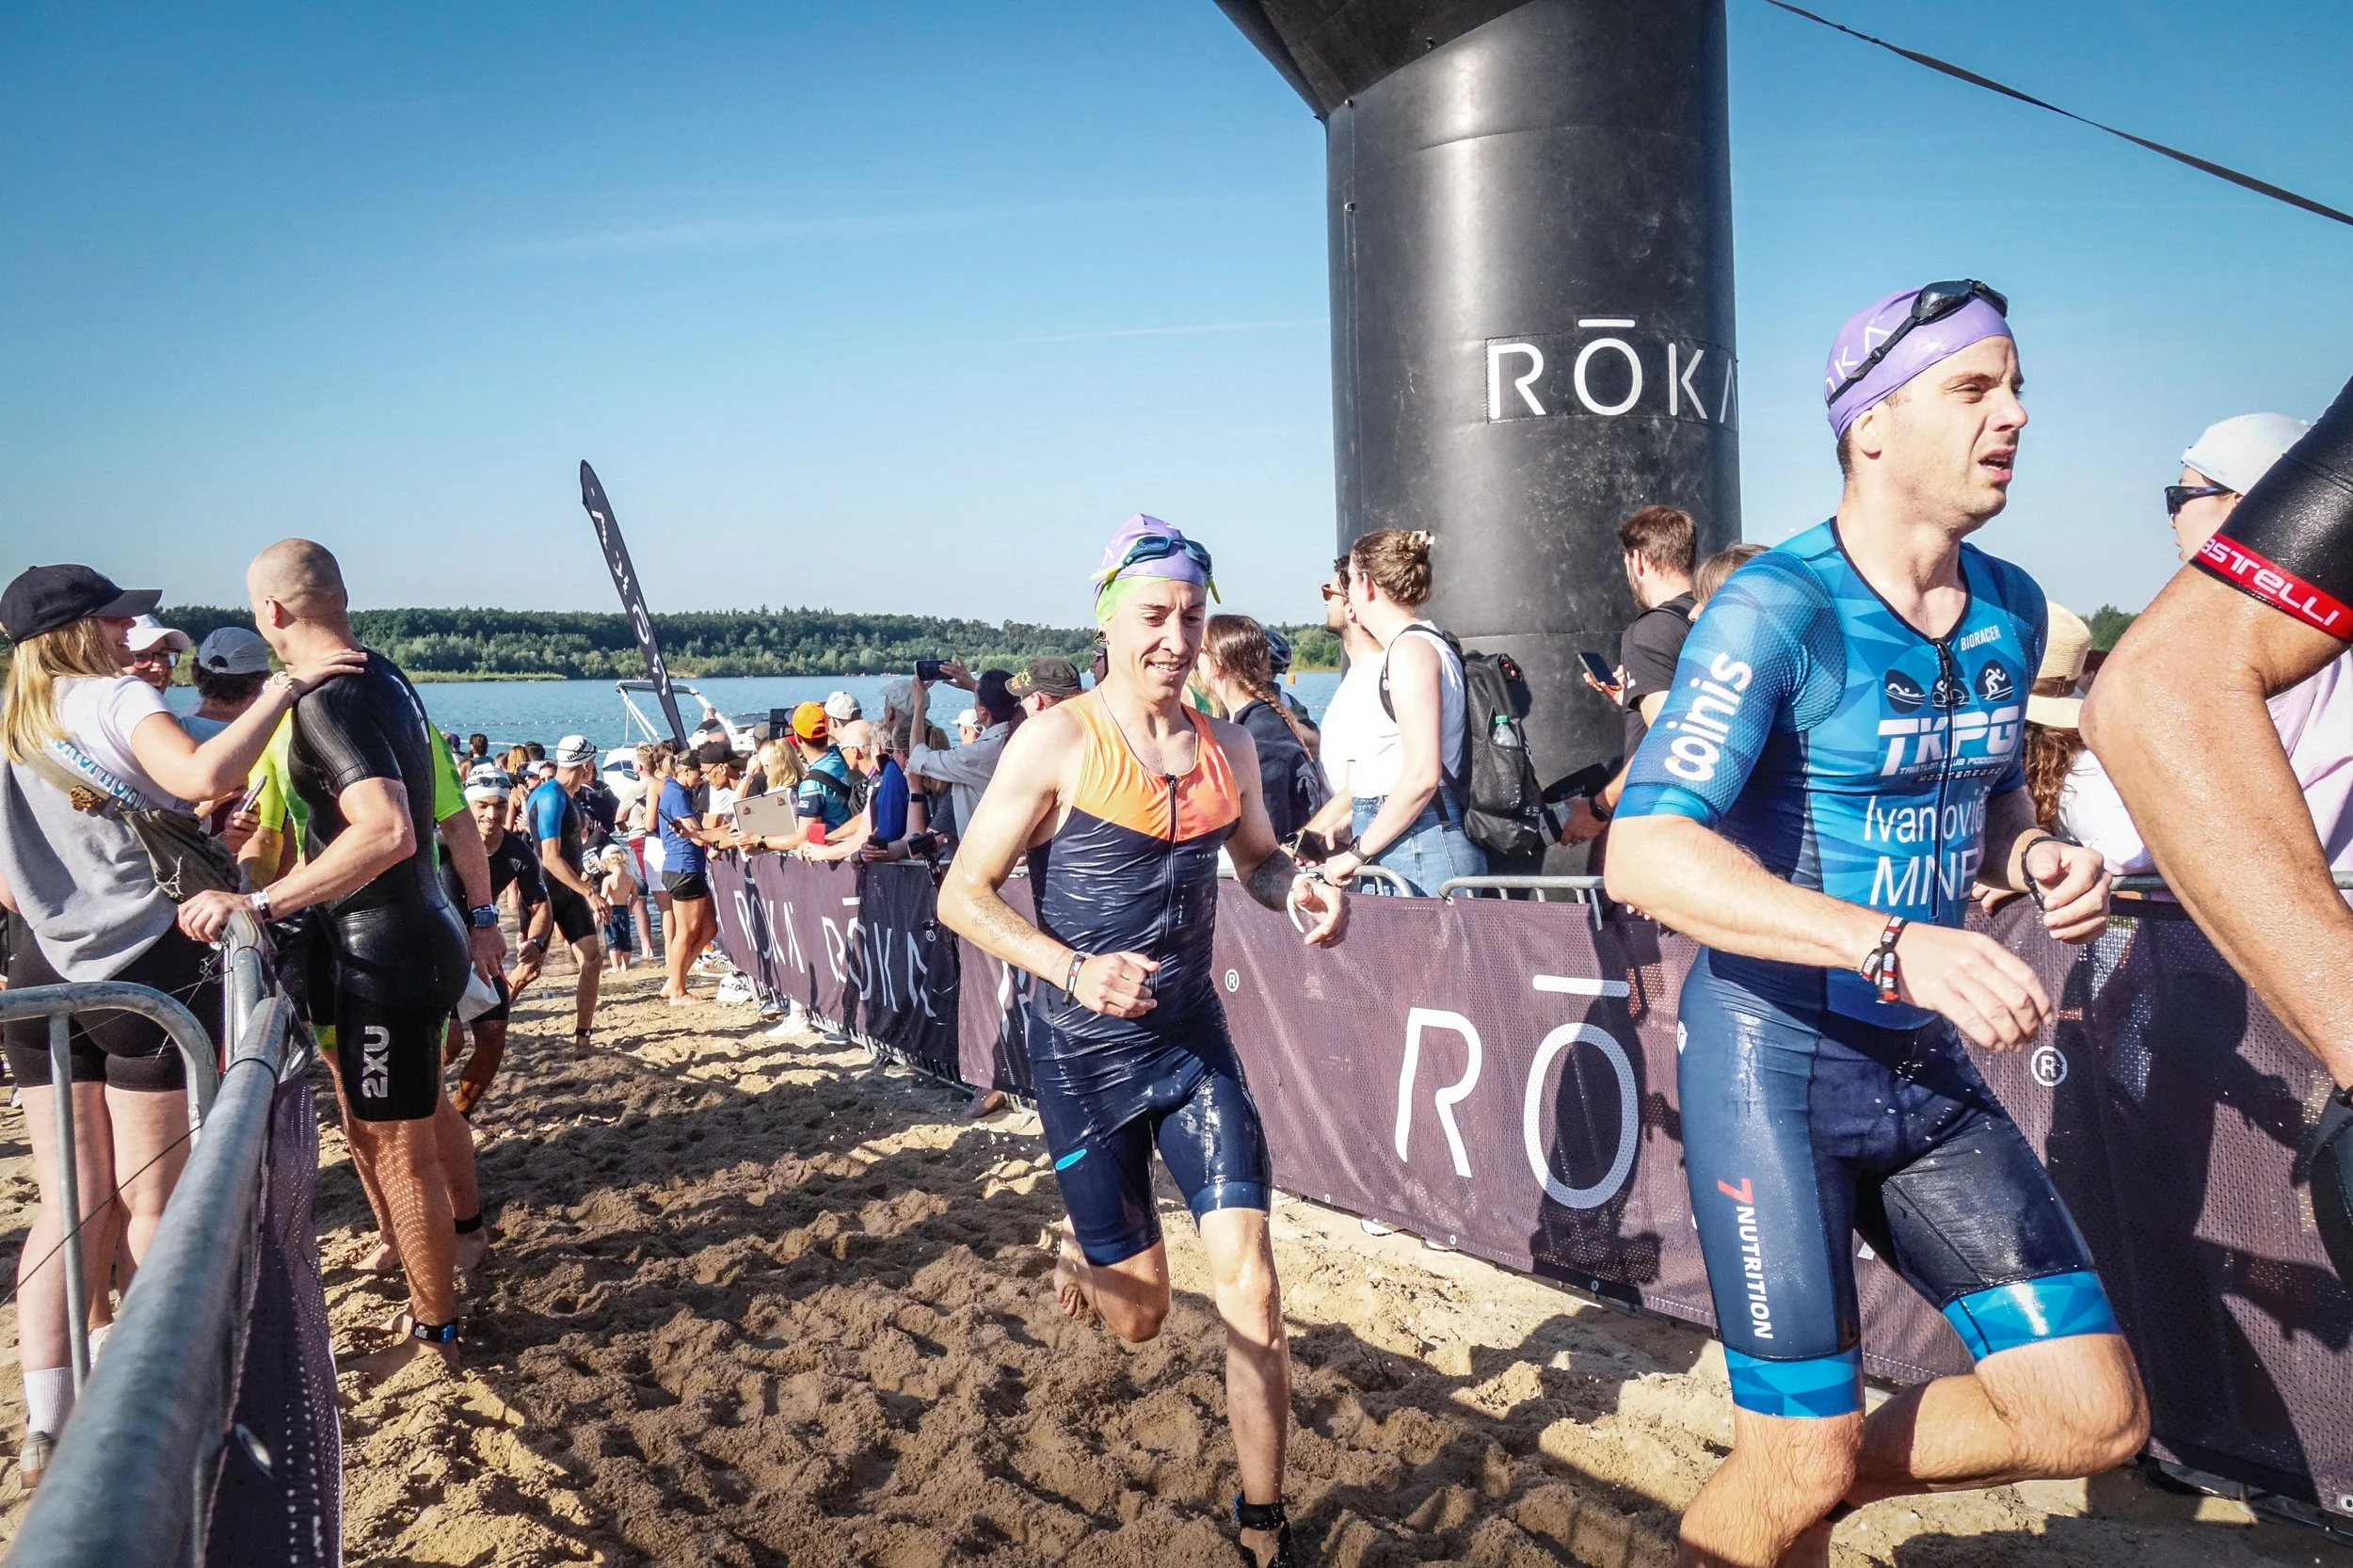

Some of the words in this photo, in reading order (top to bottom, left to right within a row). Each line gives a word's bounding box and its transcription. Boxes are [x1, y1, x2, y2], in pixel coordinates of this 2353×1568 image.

[1960, 624, 2002, 651] BIORACER
[1663, 651, 1753, 783] coinis
[1877, 705, 2020, 776] TKPG
[1869, 847, 1979, 907] MNE
[361, 1025, 391, 1099] 2XU
